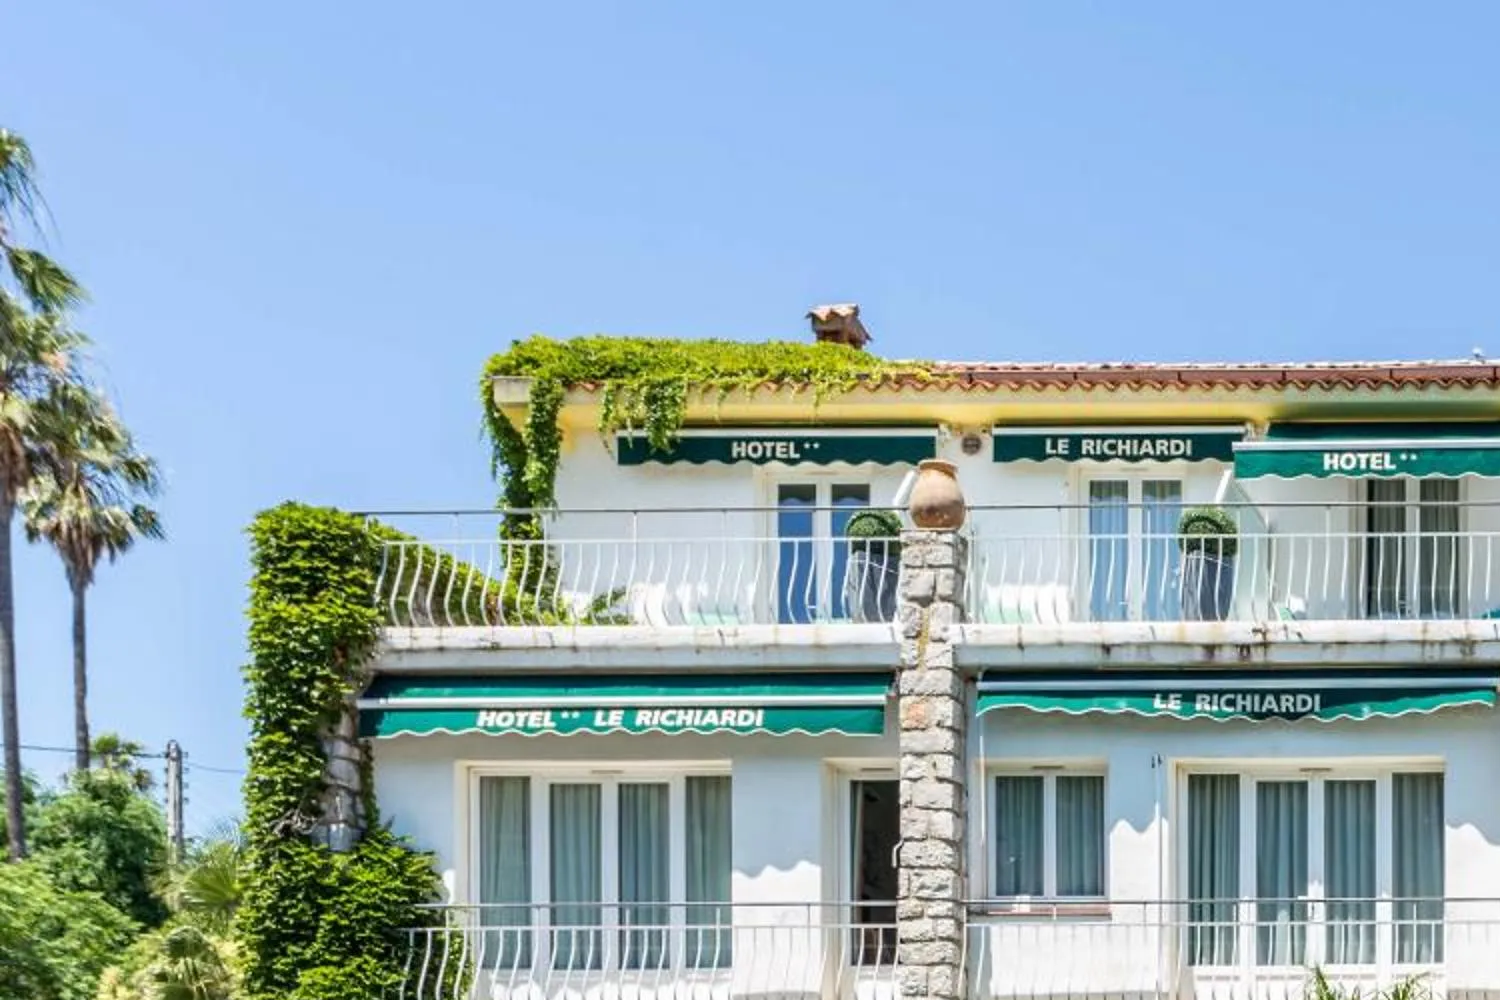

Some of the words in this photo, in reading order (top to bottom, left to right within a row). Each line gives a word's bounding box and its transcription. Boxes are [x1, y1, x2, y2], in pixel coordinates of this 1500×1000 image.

[731, 441, 800, 459] HOTEL
[1045, 438, 1070, 455] LE
[1081, 439, 1193, 456] RICHIARDI
[1323, 452, 1396, 471] HOTEL
[1153, 694, 1182, 710] LE
[1195, 694, 1321, 713] RICHIARDI
[476, 710, 556, 728] HOTEL
[594, 710, 624, 727] LE
[635, 709, 763, 727] RICHIARDI
